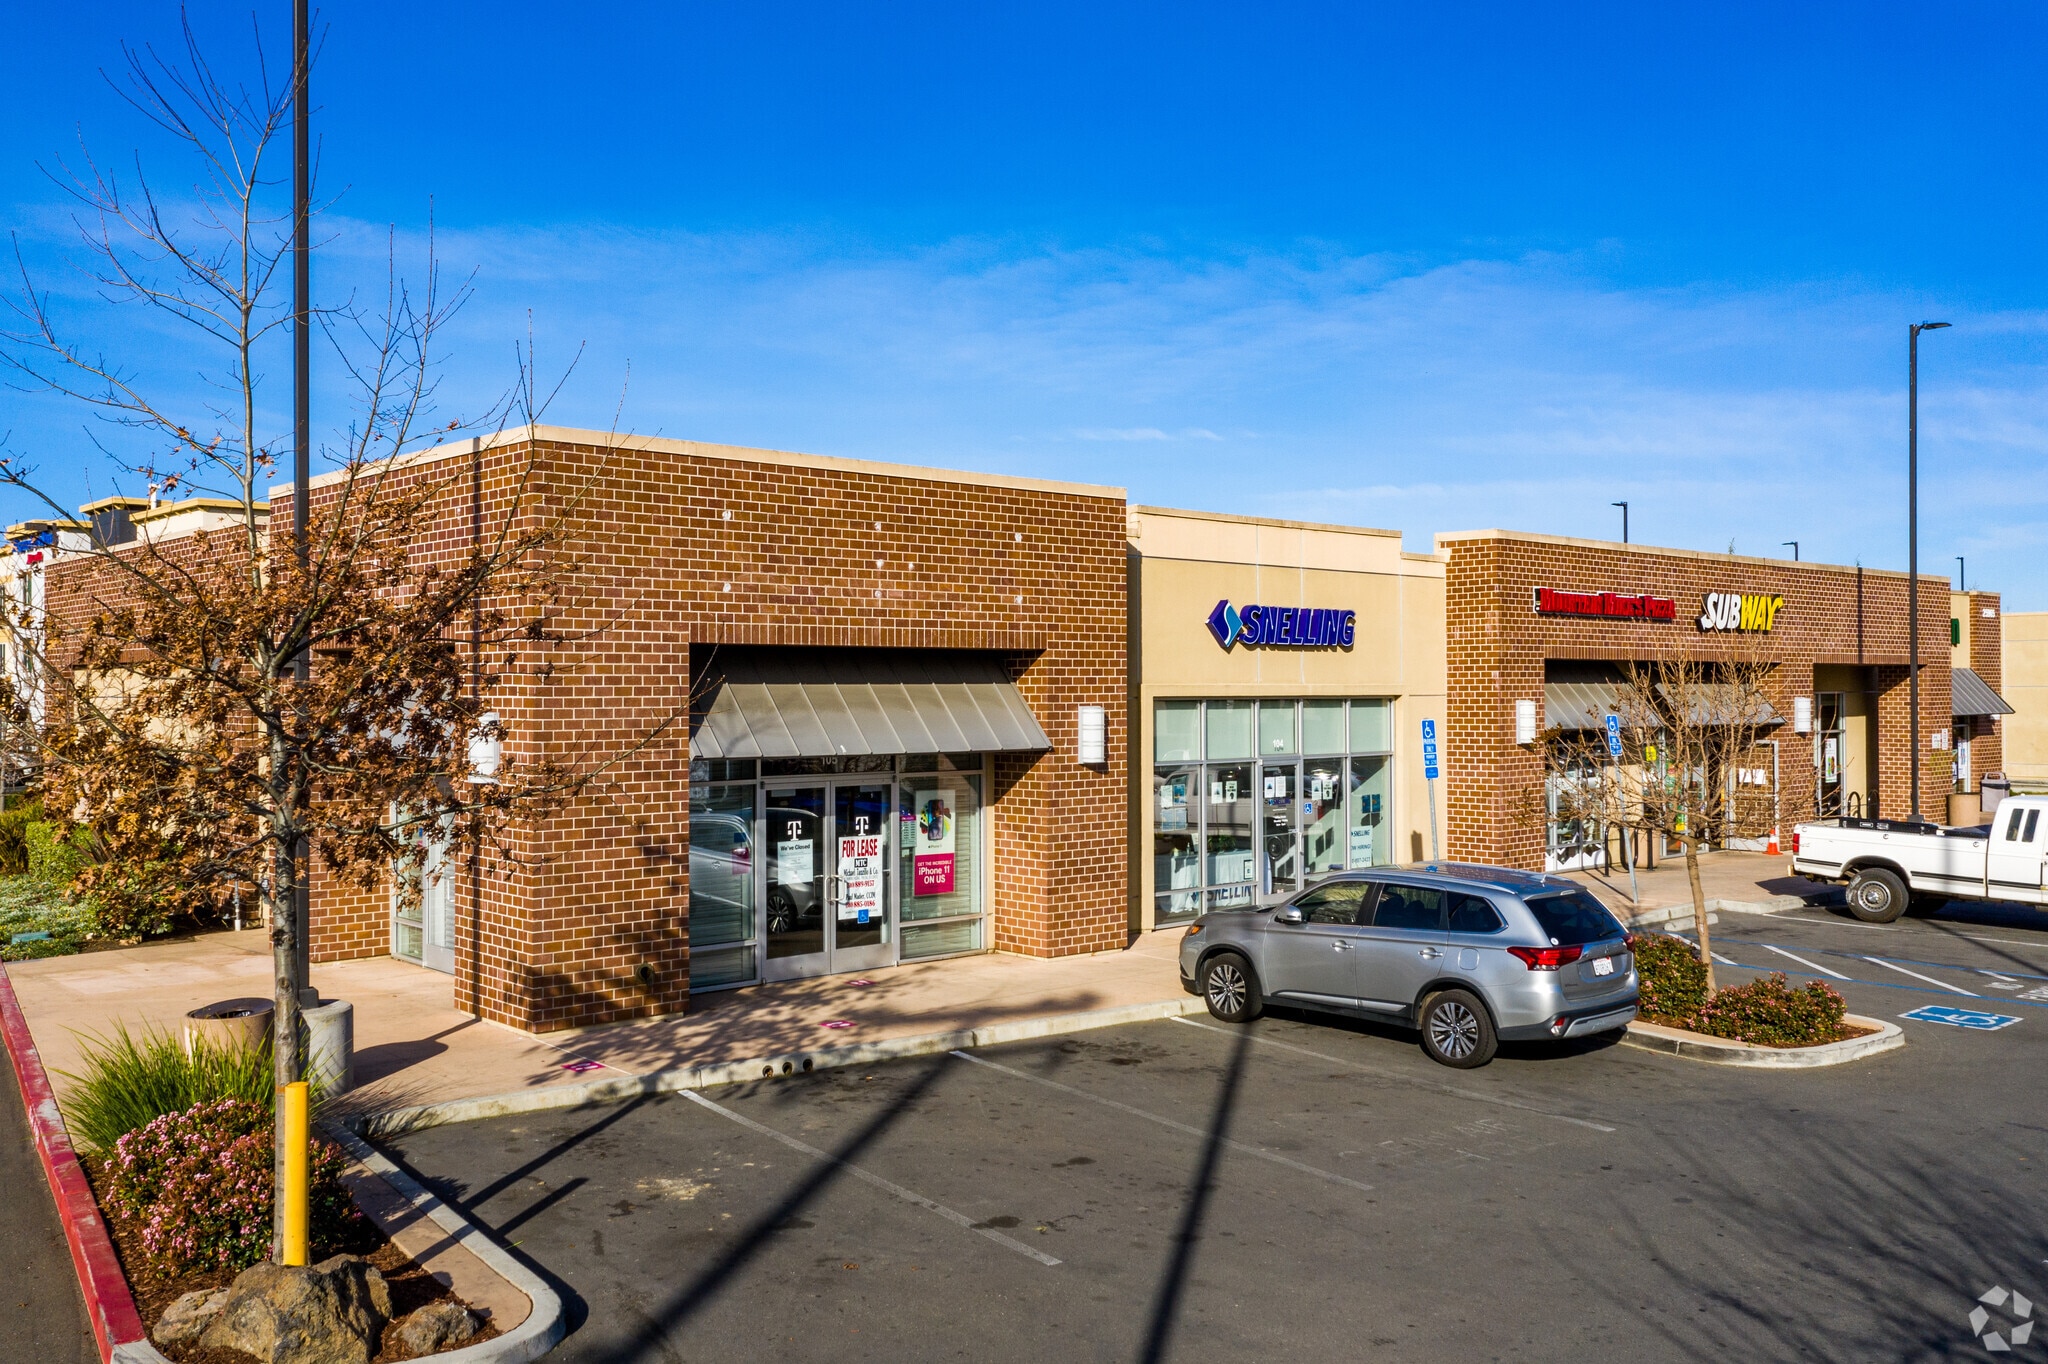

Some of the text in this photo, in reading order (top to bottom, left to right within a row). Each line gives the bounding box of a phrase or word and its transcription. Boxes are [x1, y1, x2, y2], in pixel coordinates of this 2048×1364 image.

[1701, 592, 1783, 631] SUBWAY
[1237, 605, 1356, 647] SNELLING
[842, 838, 878, 858] FOR LEASE
[924, 874, 946, 884] ON US
[944, 866, 950, 874] 11
